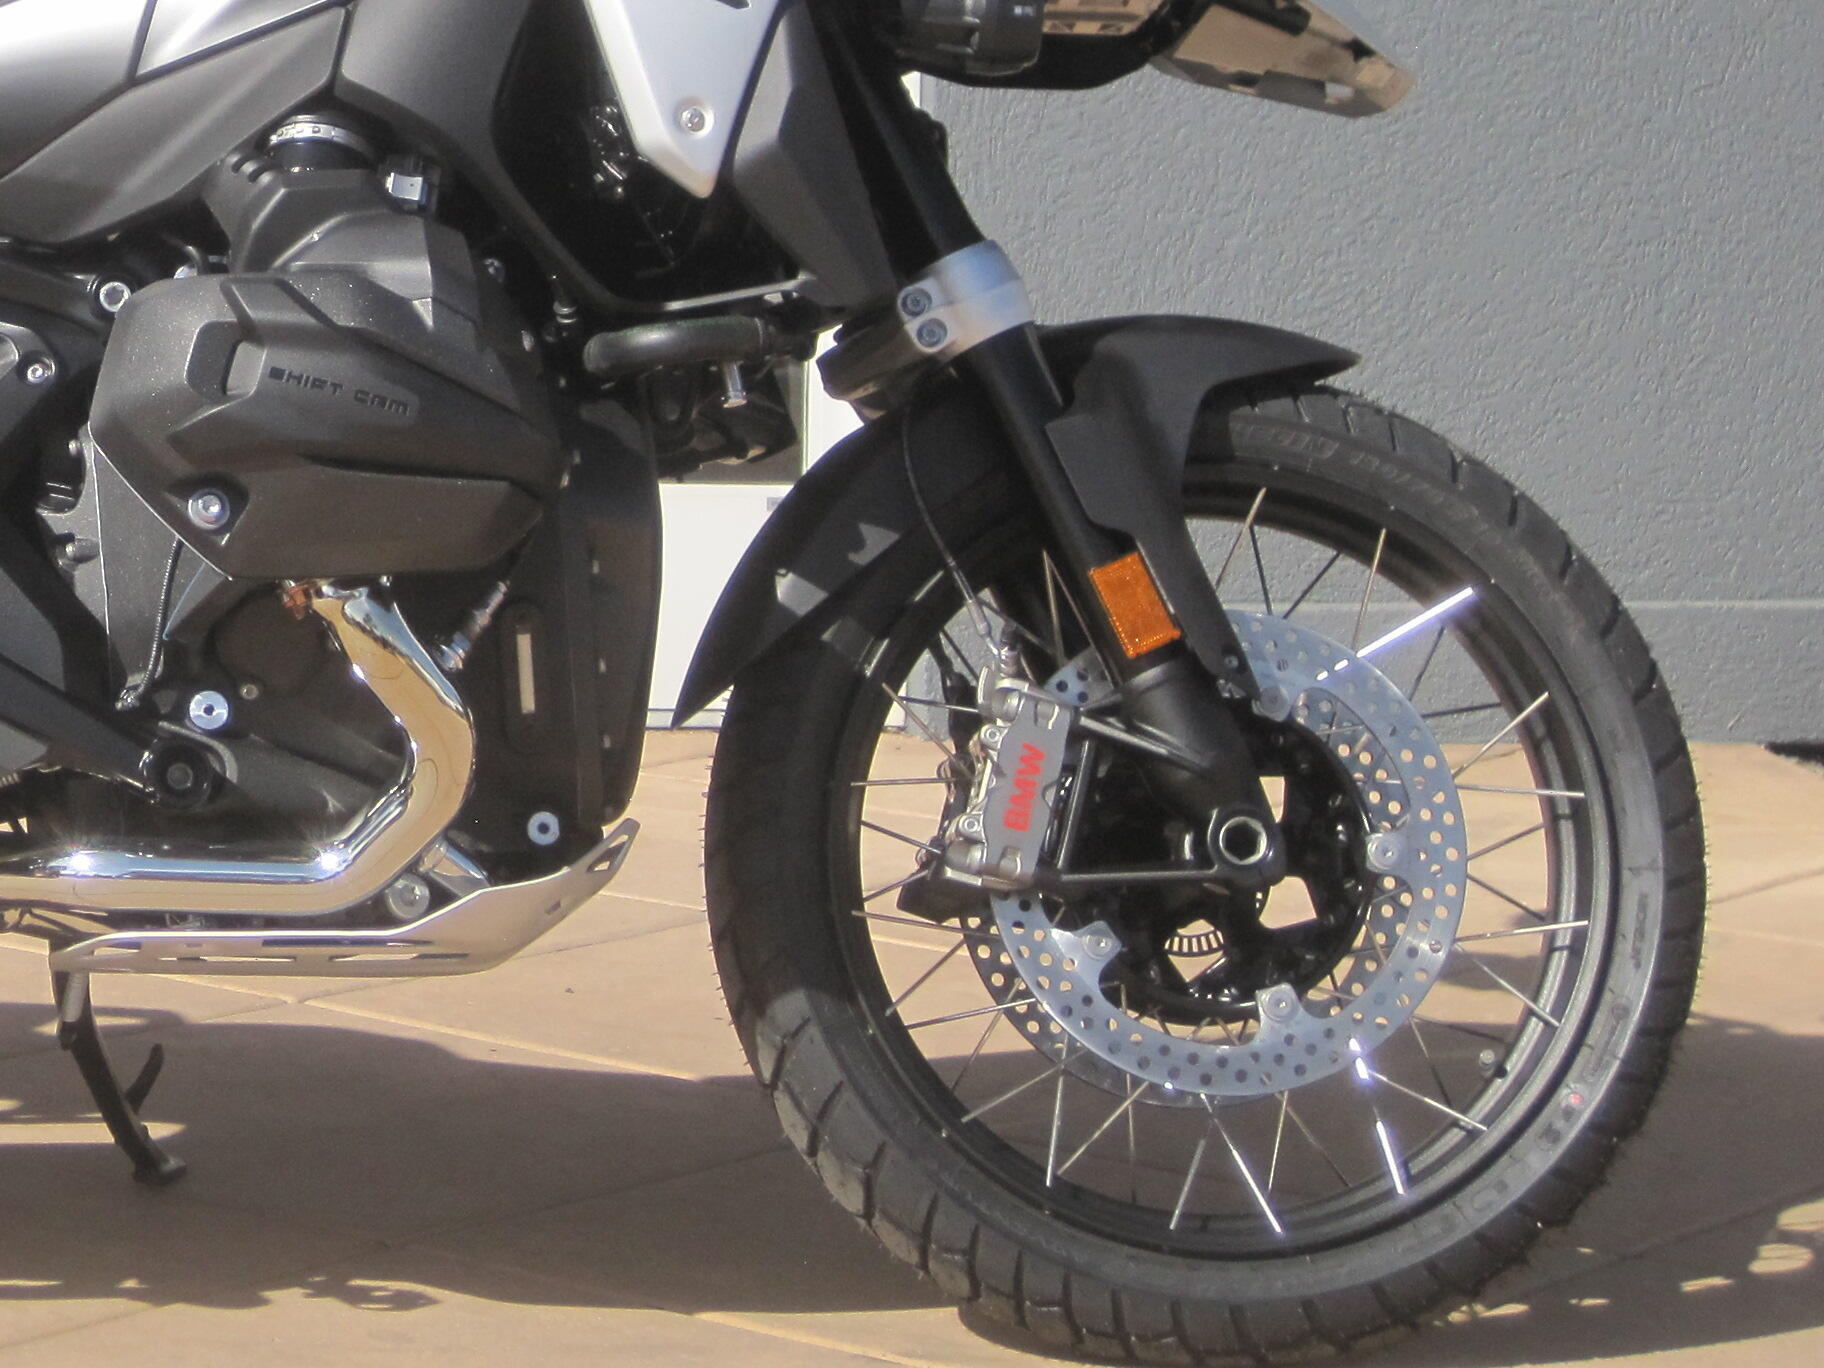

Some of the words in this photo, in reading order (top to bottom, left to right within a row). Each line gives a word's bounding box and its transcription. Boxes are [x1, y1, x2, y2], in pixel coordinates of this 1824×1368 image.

[268, 366, 344, 398] SHIFT
[353, 389, 411, 417] CAM
[1003, 742, 1046, 833] BMW
